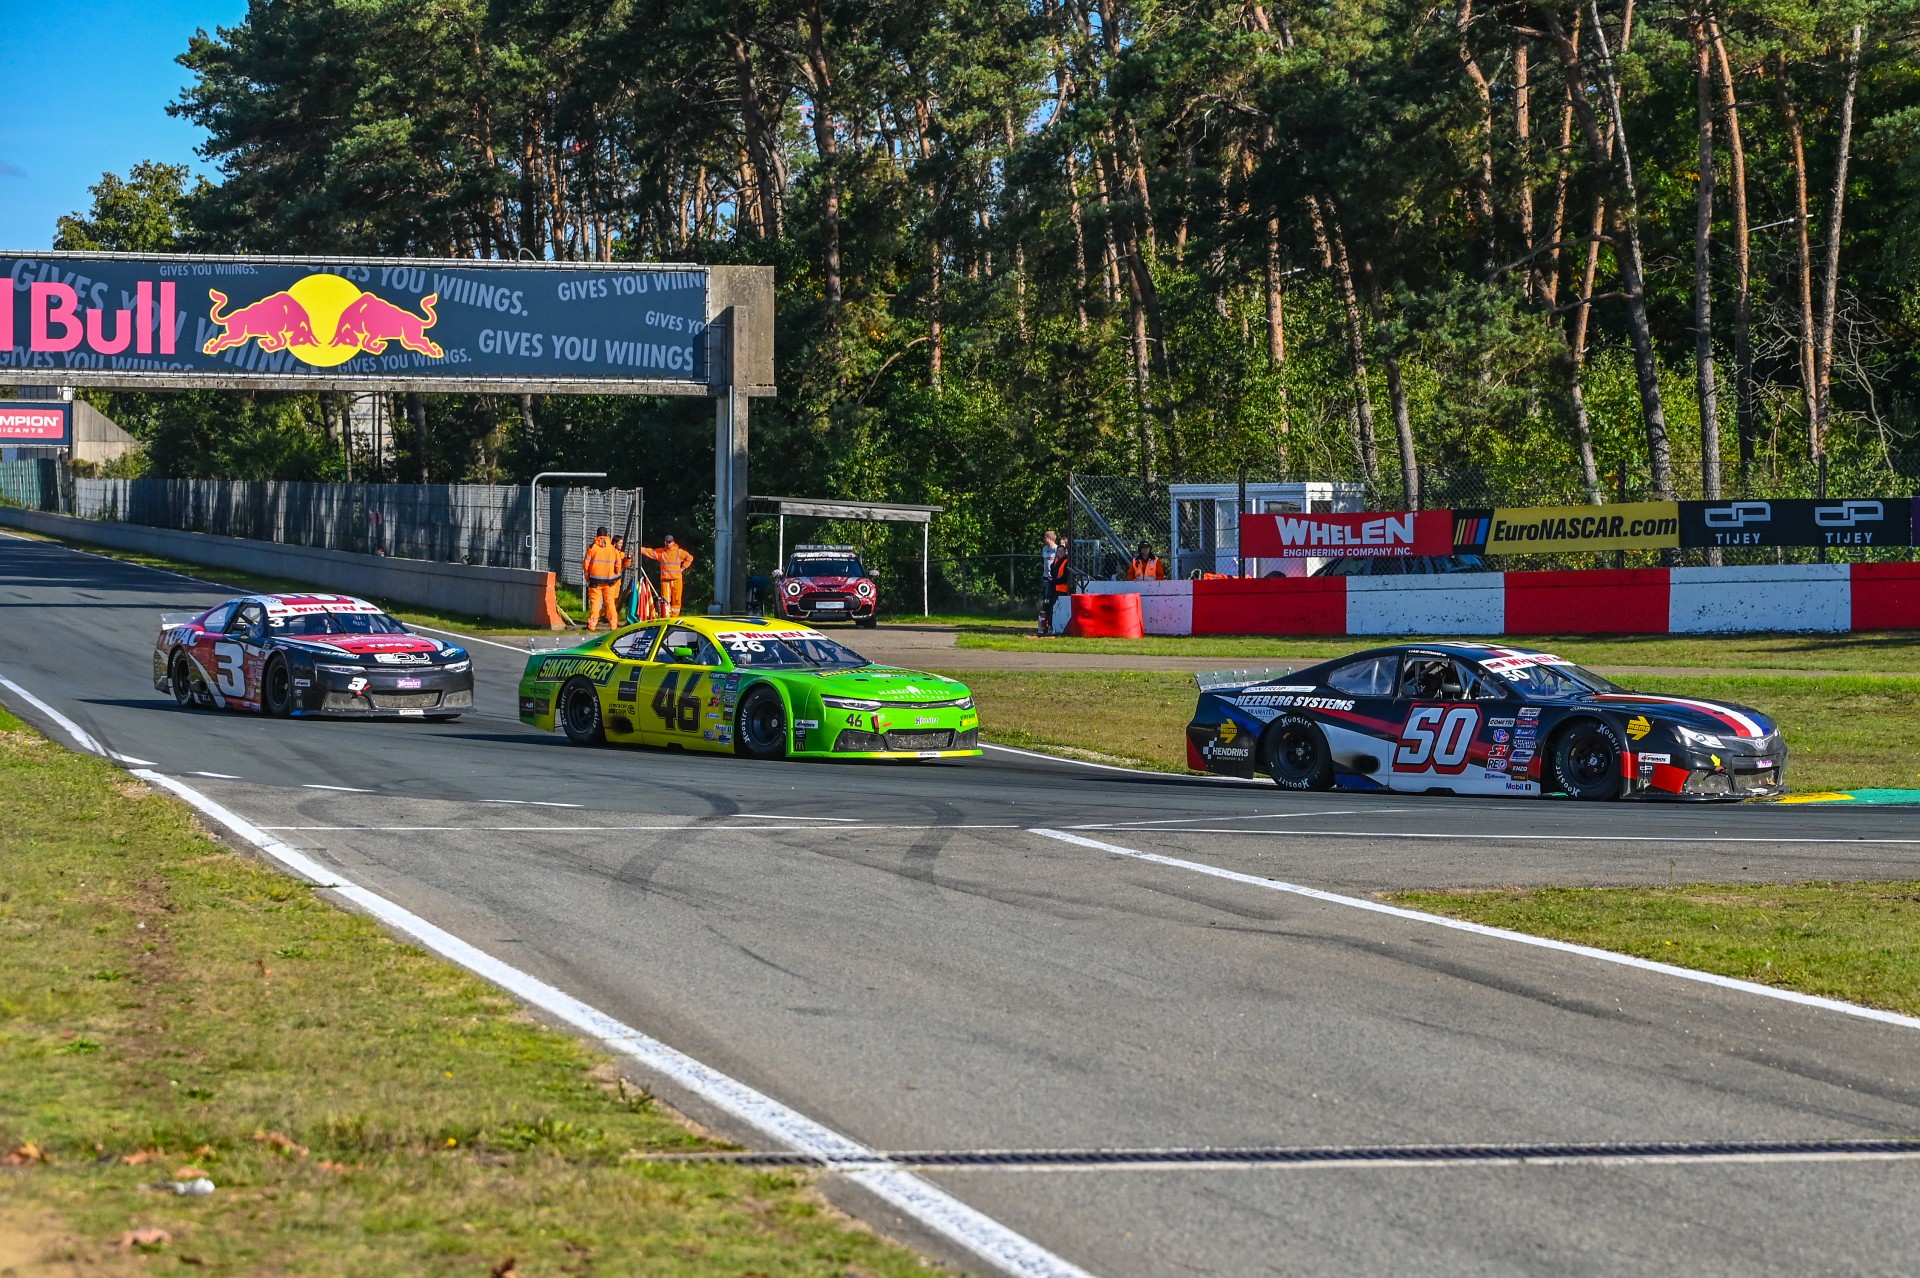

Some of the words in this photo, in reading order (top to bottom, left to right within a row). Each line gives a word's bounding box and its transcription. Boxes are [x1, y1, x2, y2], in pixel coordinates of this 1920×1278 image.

[160, 265, 188, 276] GIVES
[191, 265, 212, 275] YOU
[214, 265, 258, 275] WIIINGS.
[433, 273, 528, 317] WIIINGS.
[557, 277, 607, 301] GIVES
[611, 274, 648, 295] YOU
[31, 281, 175, 354] Bull
[645, 310, 683, 331] GIVES
[478, 329, 543, 358] GIVES
[552, 335, 597, 363] YOU
[605, 340, 693, 372] WIIINGS
[337, 357, 376, 373] GIVES
[380, 353, 408, 370] YOU
[1275, 512, 1414, 545] WHELEN
[1493, 516, 1677, 542] EuroNASCAR.com
[1716, 533, 1761, 544] TIJEY
[1825, 533, 1873, 544] TIJEY
[1283, 548, 1344, 557] ENGINEERING
[1346, 548, 1392, 556] COMPANY
[1394, 547, 1413, 556] INC.
[268, 617, 285, 627] 3
[730, 641, 765, 653] 46
[214, 642, 246, 697] 3
[539, 659, 613, 681] SIMTHUNDER
[1501, 669, 1530, 681] 50
[347, 677, 367, 691] 3
[651, 671, 703, 732] 46
[1234, 695, 1294, 706] HEZEBERG
[1293, 696, 1355, 711] SYSTEMS
[845, 713, 863, 727] 46
[1281, 716, 1312, 728] Hoosier
[1394, 705, 1480, 768] 50
[1597, 723, 1621, 754] Hoosier
[1212, 747, 1248, 757] HENDRIKS
[1278, 776, 1310, 789] Hoosier
[1555, 765, 1581, 797] Hoosier
